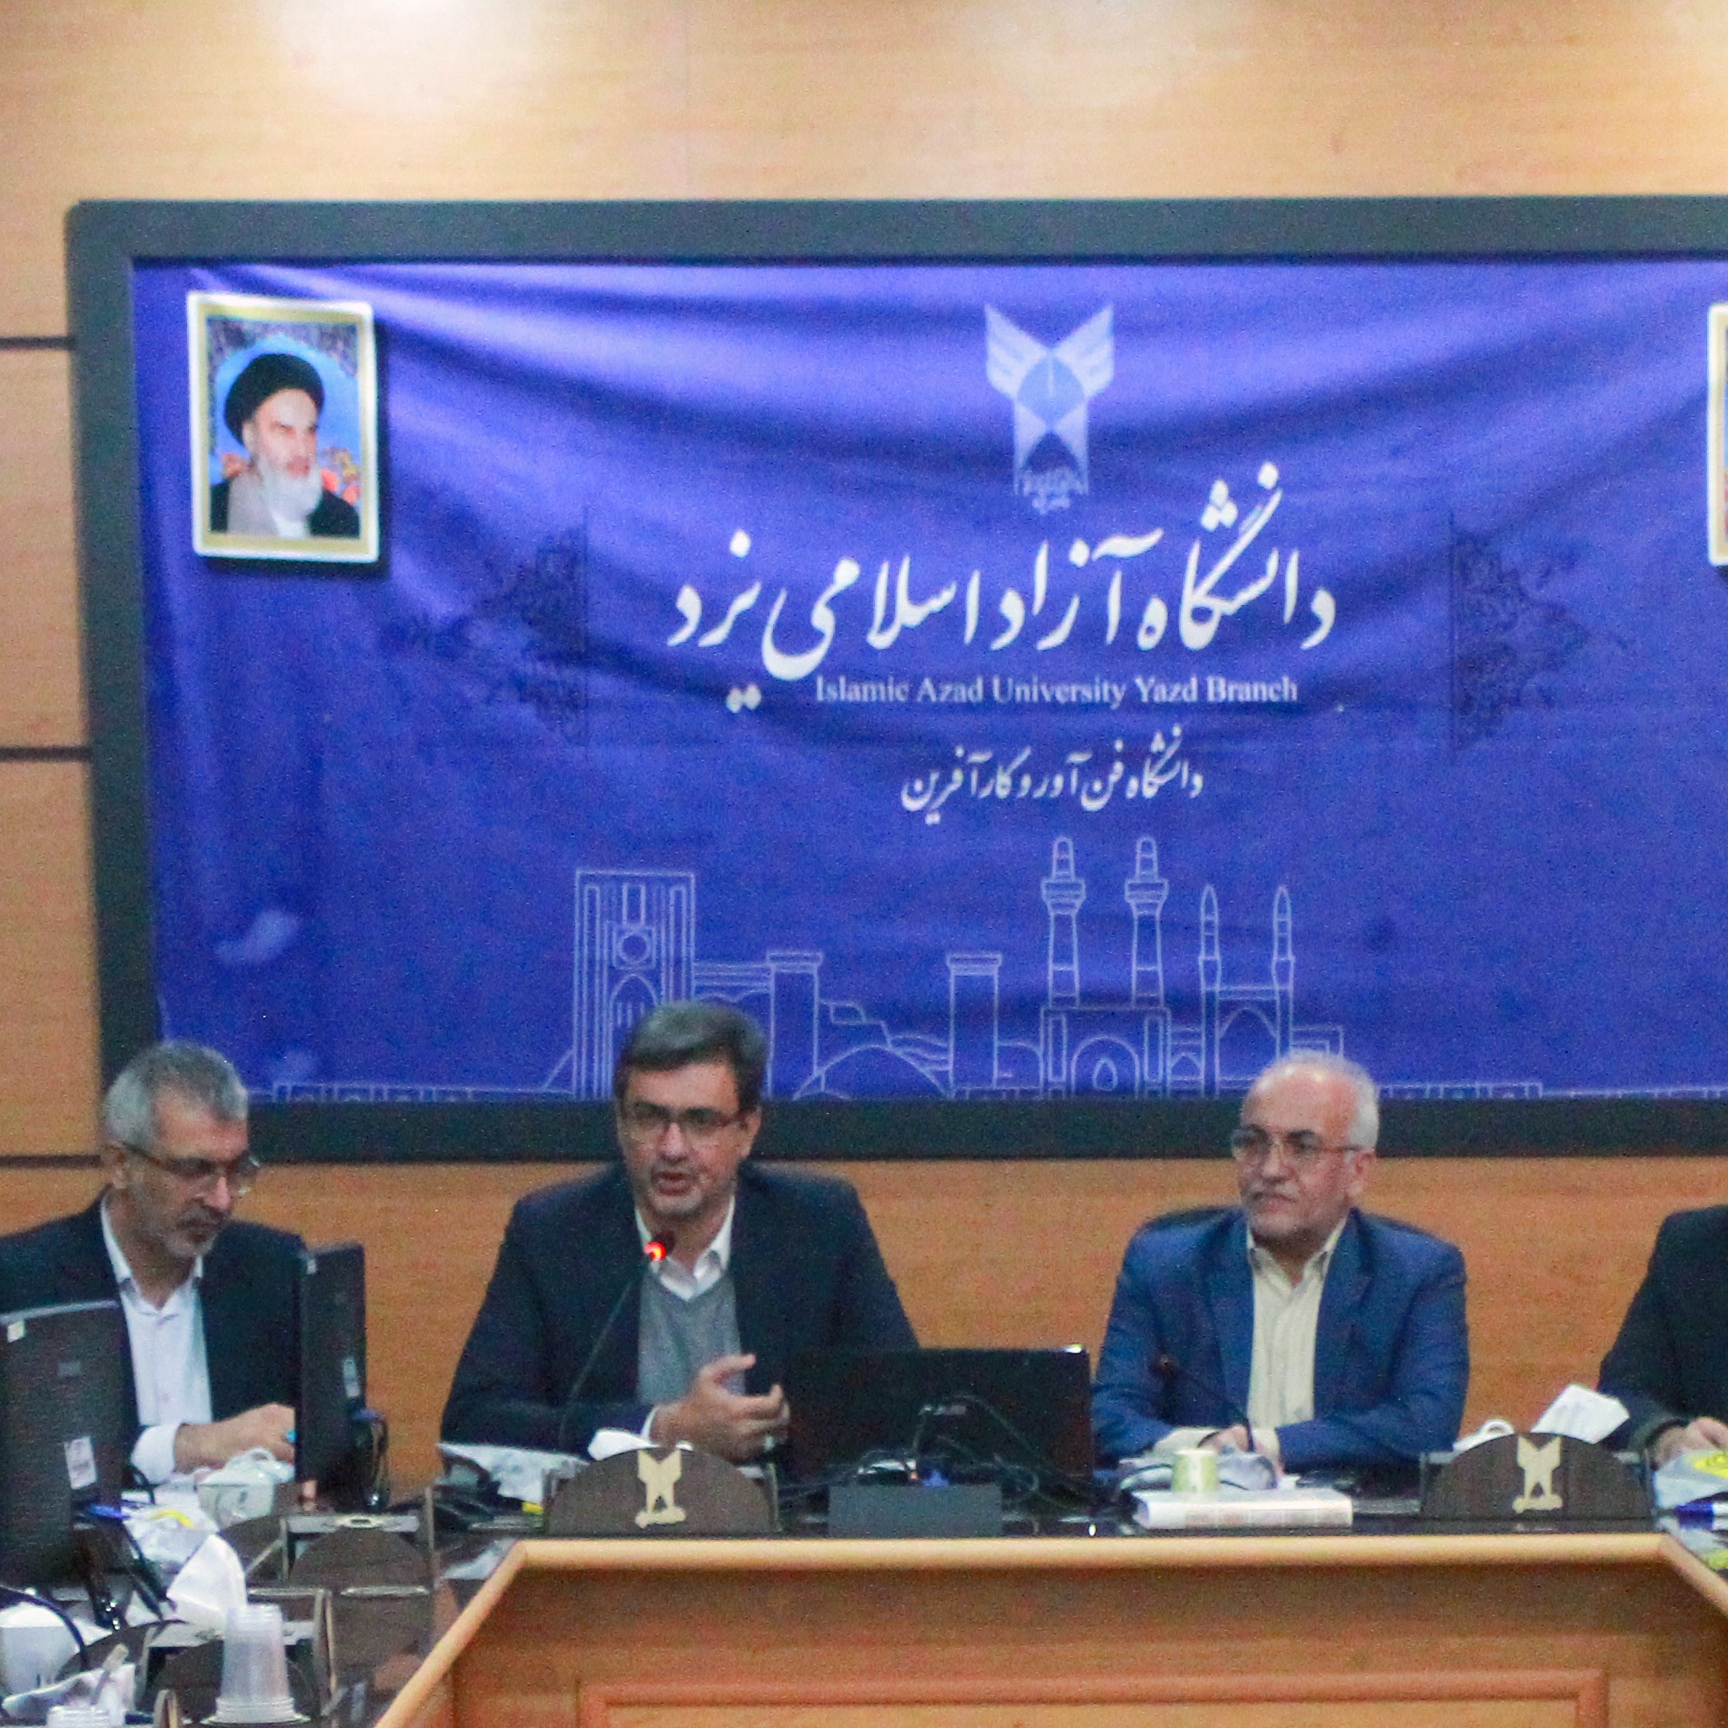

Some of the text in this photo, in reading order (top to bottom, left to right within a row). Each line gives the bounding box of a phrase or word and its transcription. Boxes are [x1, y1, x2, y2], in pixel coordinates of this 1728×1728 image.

[668, 461, 1336, 712] دانشگاه آزاد اسلامی یزد
[815, 675, 1298, 710] Islamic Azad University Yazd Branch
[1125, 724, 1204, 800] دانشگاه
